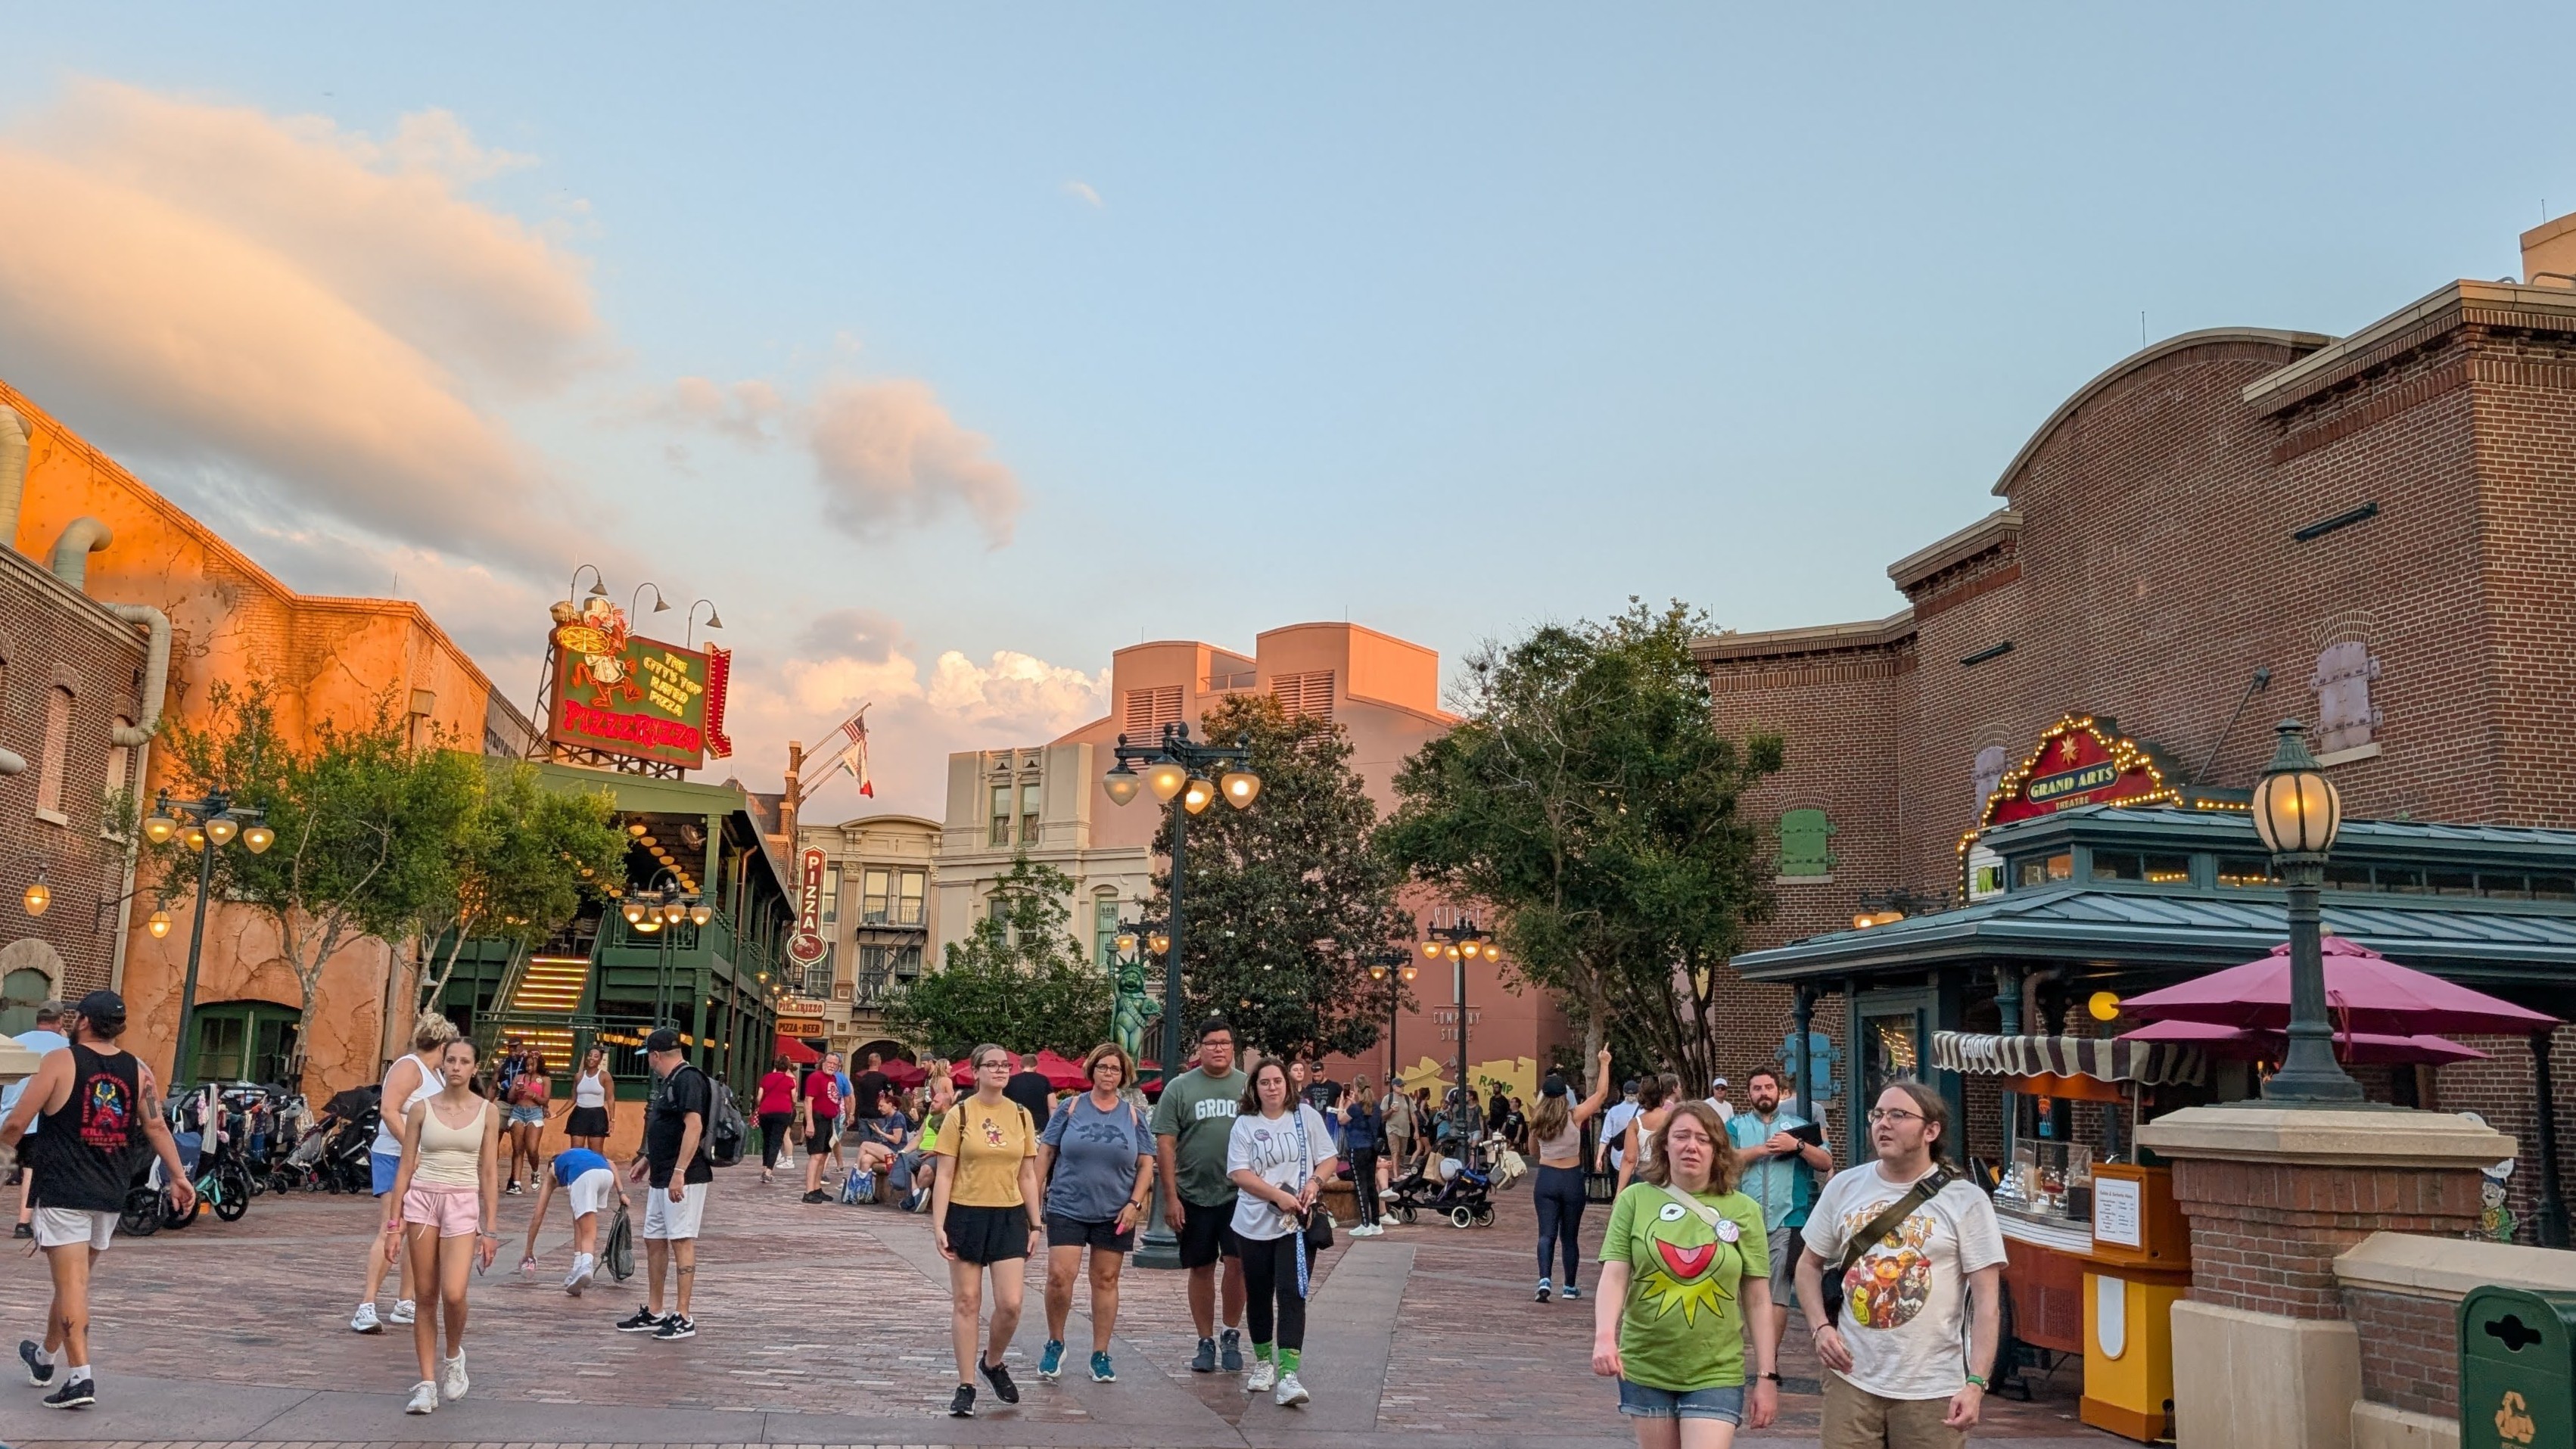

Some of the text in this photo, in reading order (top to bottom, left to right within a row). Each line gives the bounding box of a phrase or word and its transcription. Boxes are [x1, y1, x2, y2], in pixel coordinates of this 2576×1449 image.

[665, 652, 688, 673] THE
[643, 657, 703, 695] CITY'S TOP
[650, 676, 689, 704] RATED
[649, 689, 683, 717] PIZZA
[2030, 766, 2114, 798] GRAND ARTS
[2055, 795, 2089, 811] THEATRE
[802, 856, 820, 929] PIZZA
[778, 1023, 820, 1034] PIZZA BEER
[1433, 1012, 1480, 1025] COMPNY
[1441, 1028, 1472, 1041] STOE
[1194, 1098, 1238, 1120] GROO
[1252, 1132, 1300, 1177] BRID
